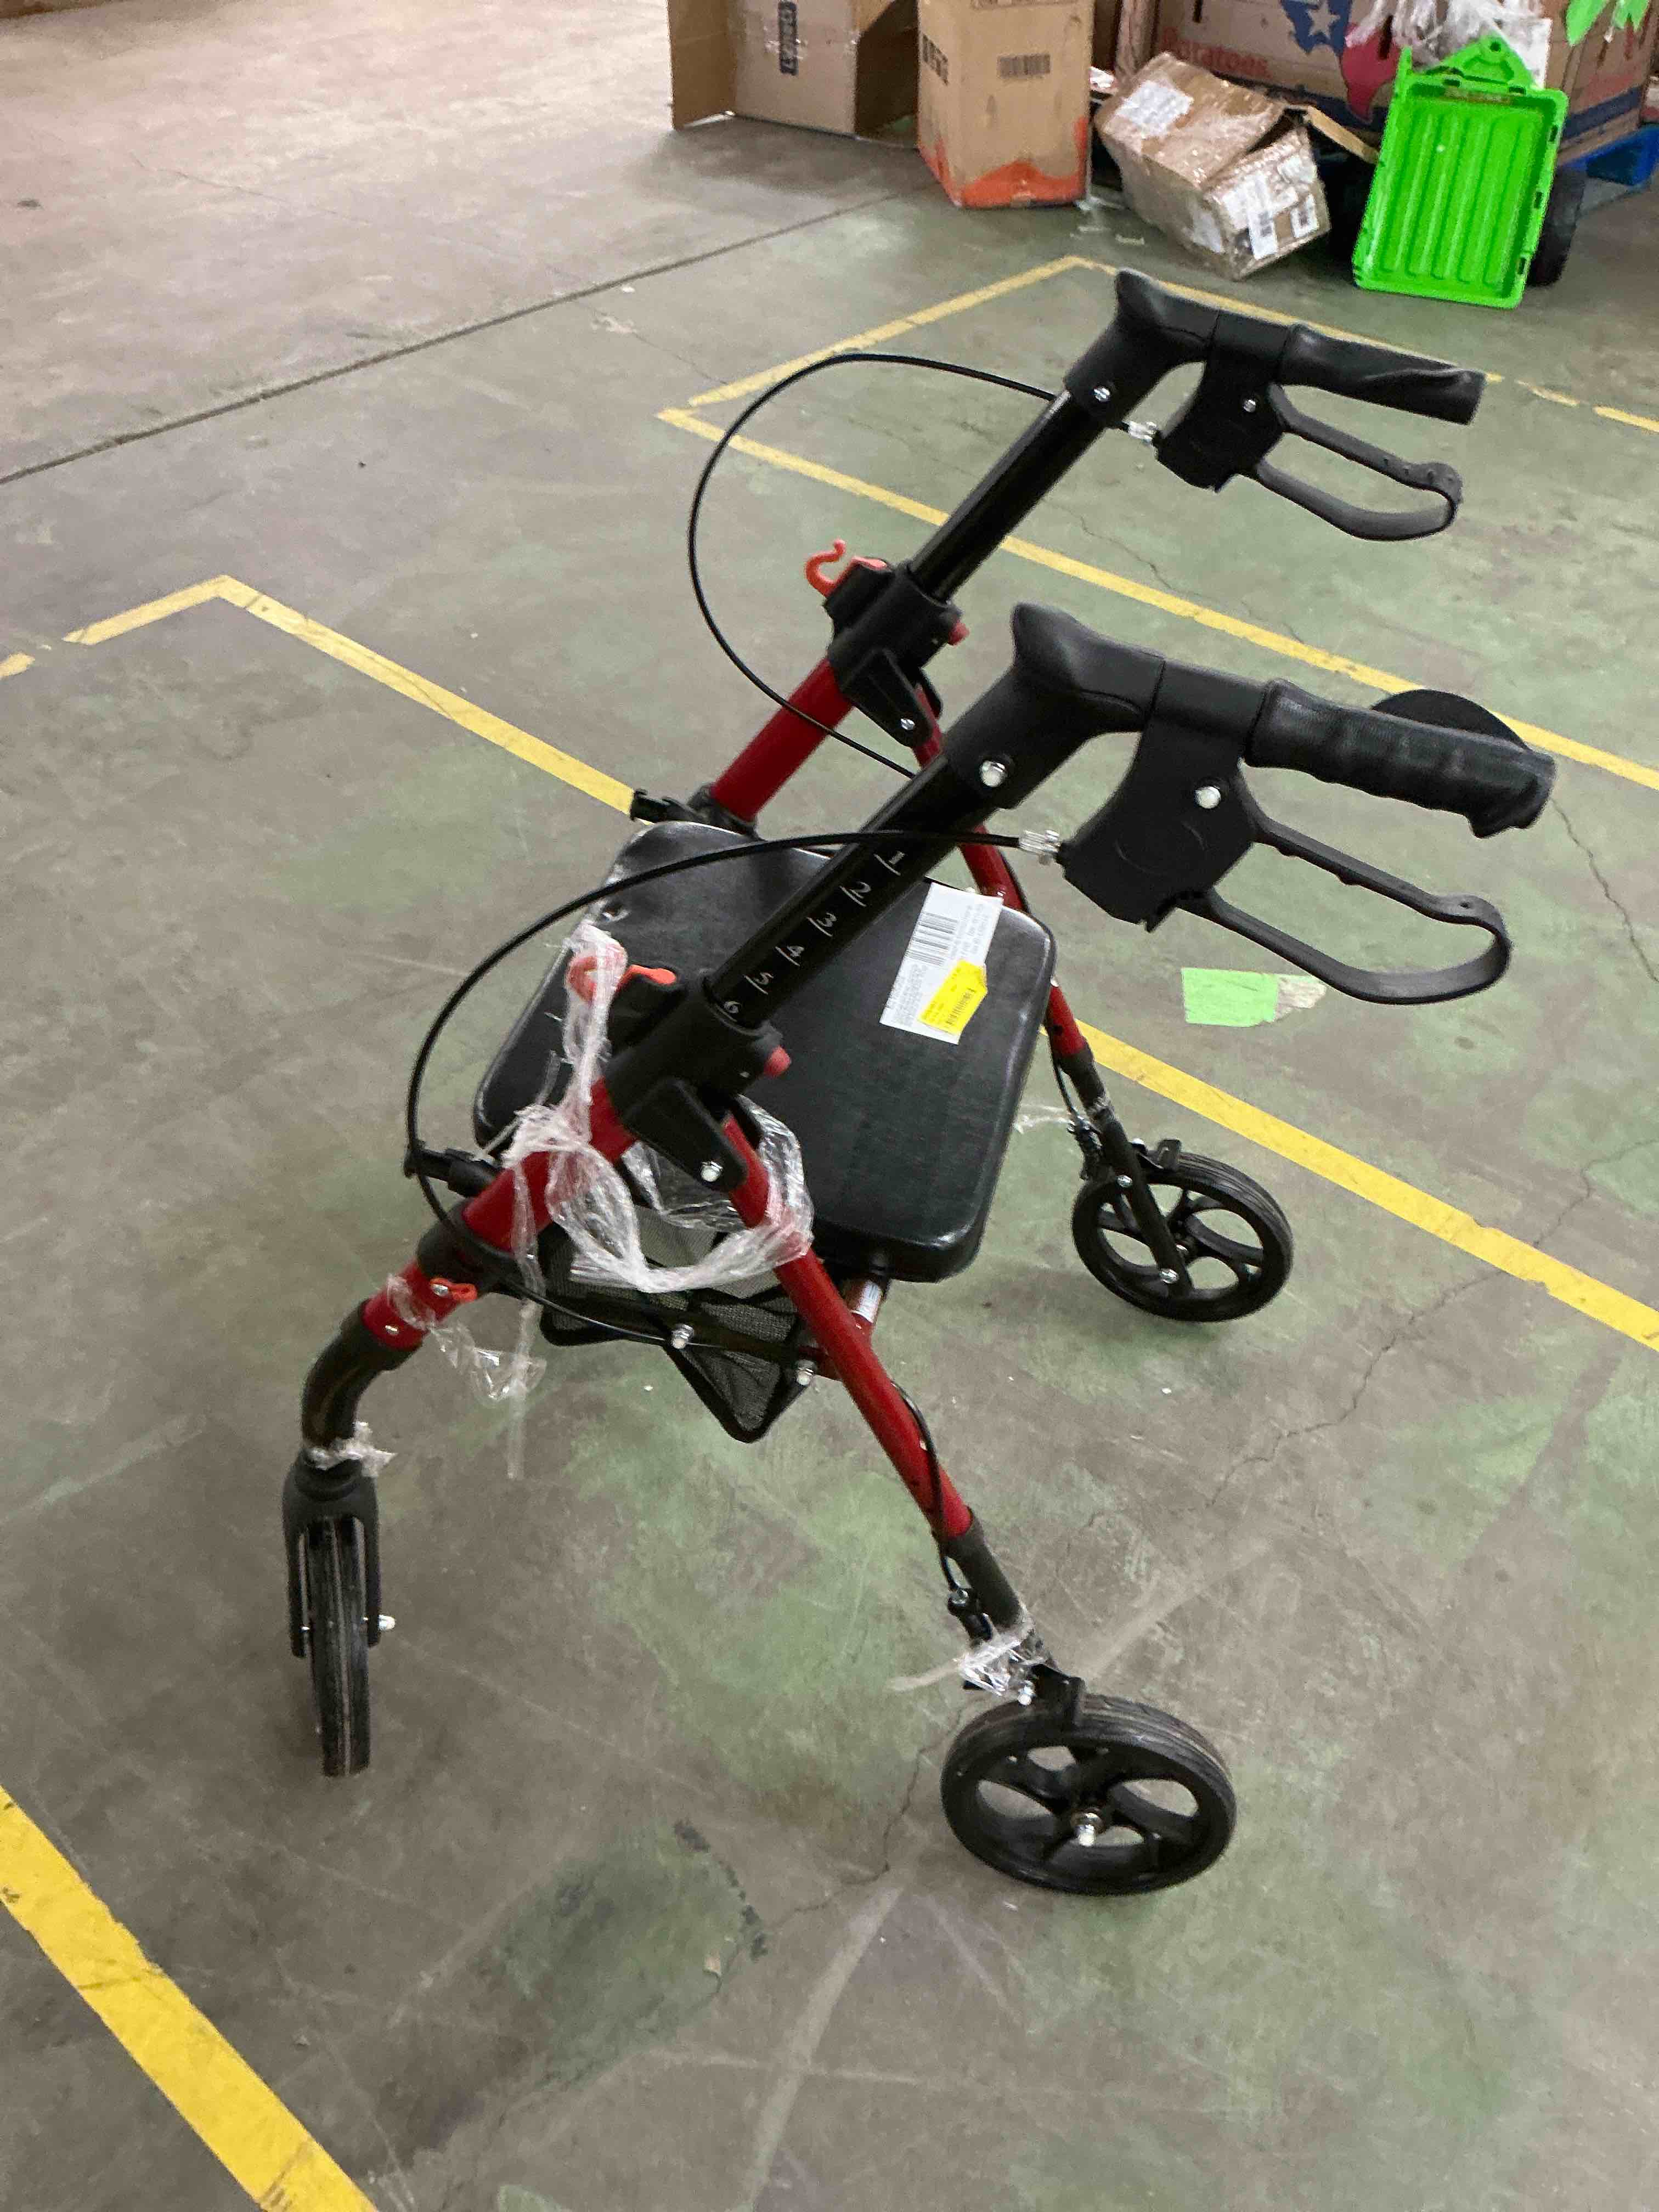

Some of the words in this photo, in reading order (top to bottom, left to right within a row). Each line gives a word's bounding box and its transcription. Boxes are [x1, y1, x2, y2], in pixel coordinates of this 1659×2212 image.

[888, 851, 905, 865] 1
[850, 882, 871, 899] 2
[816, 912, 837, 928] 3
[787, 945, 805, 957] 4
[752, 972, 774, 985] 5
[724, 1001, 740, 1014] 6
